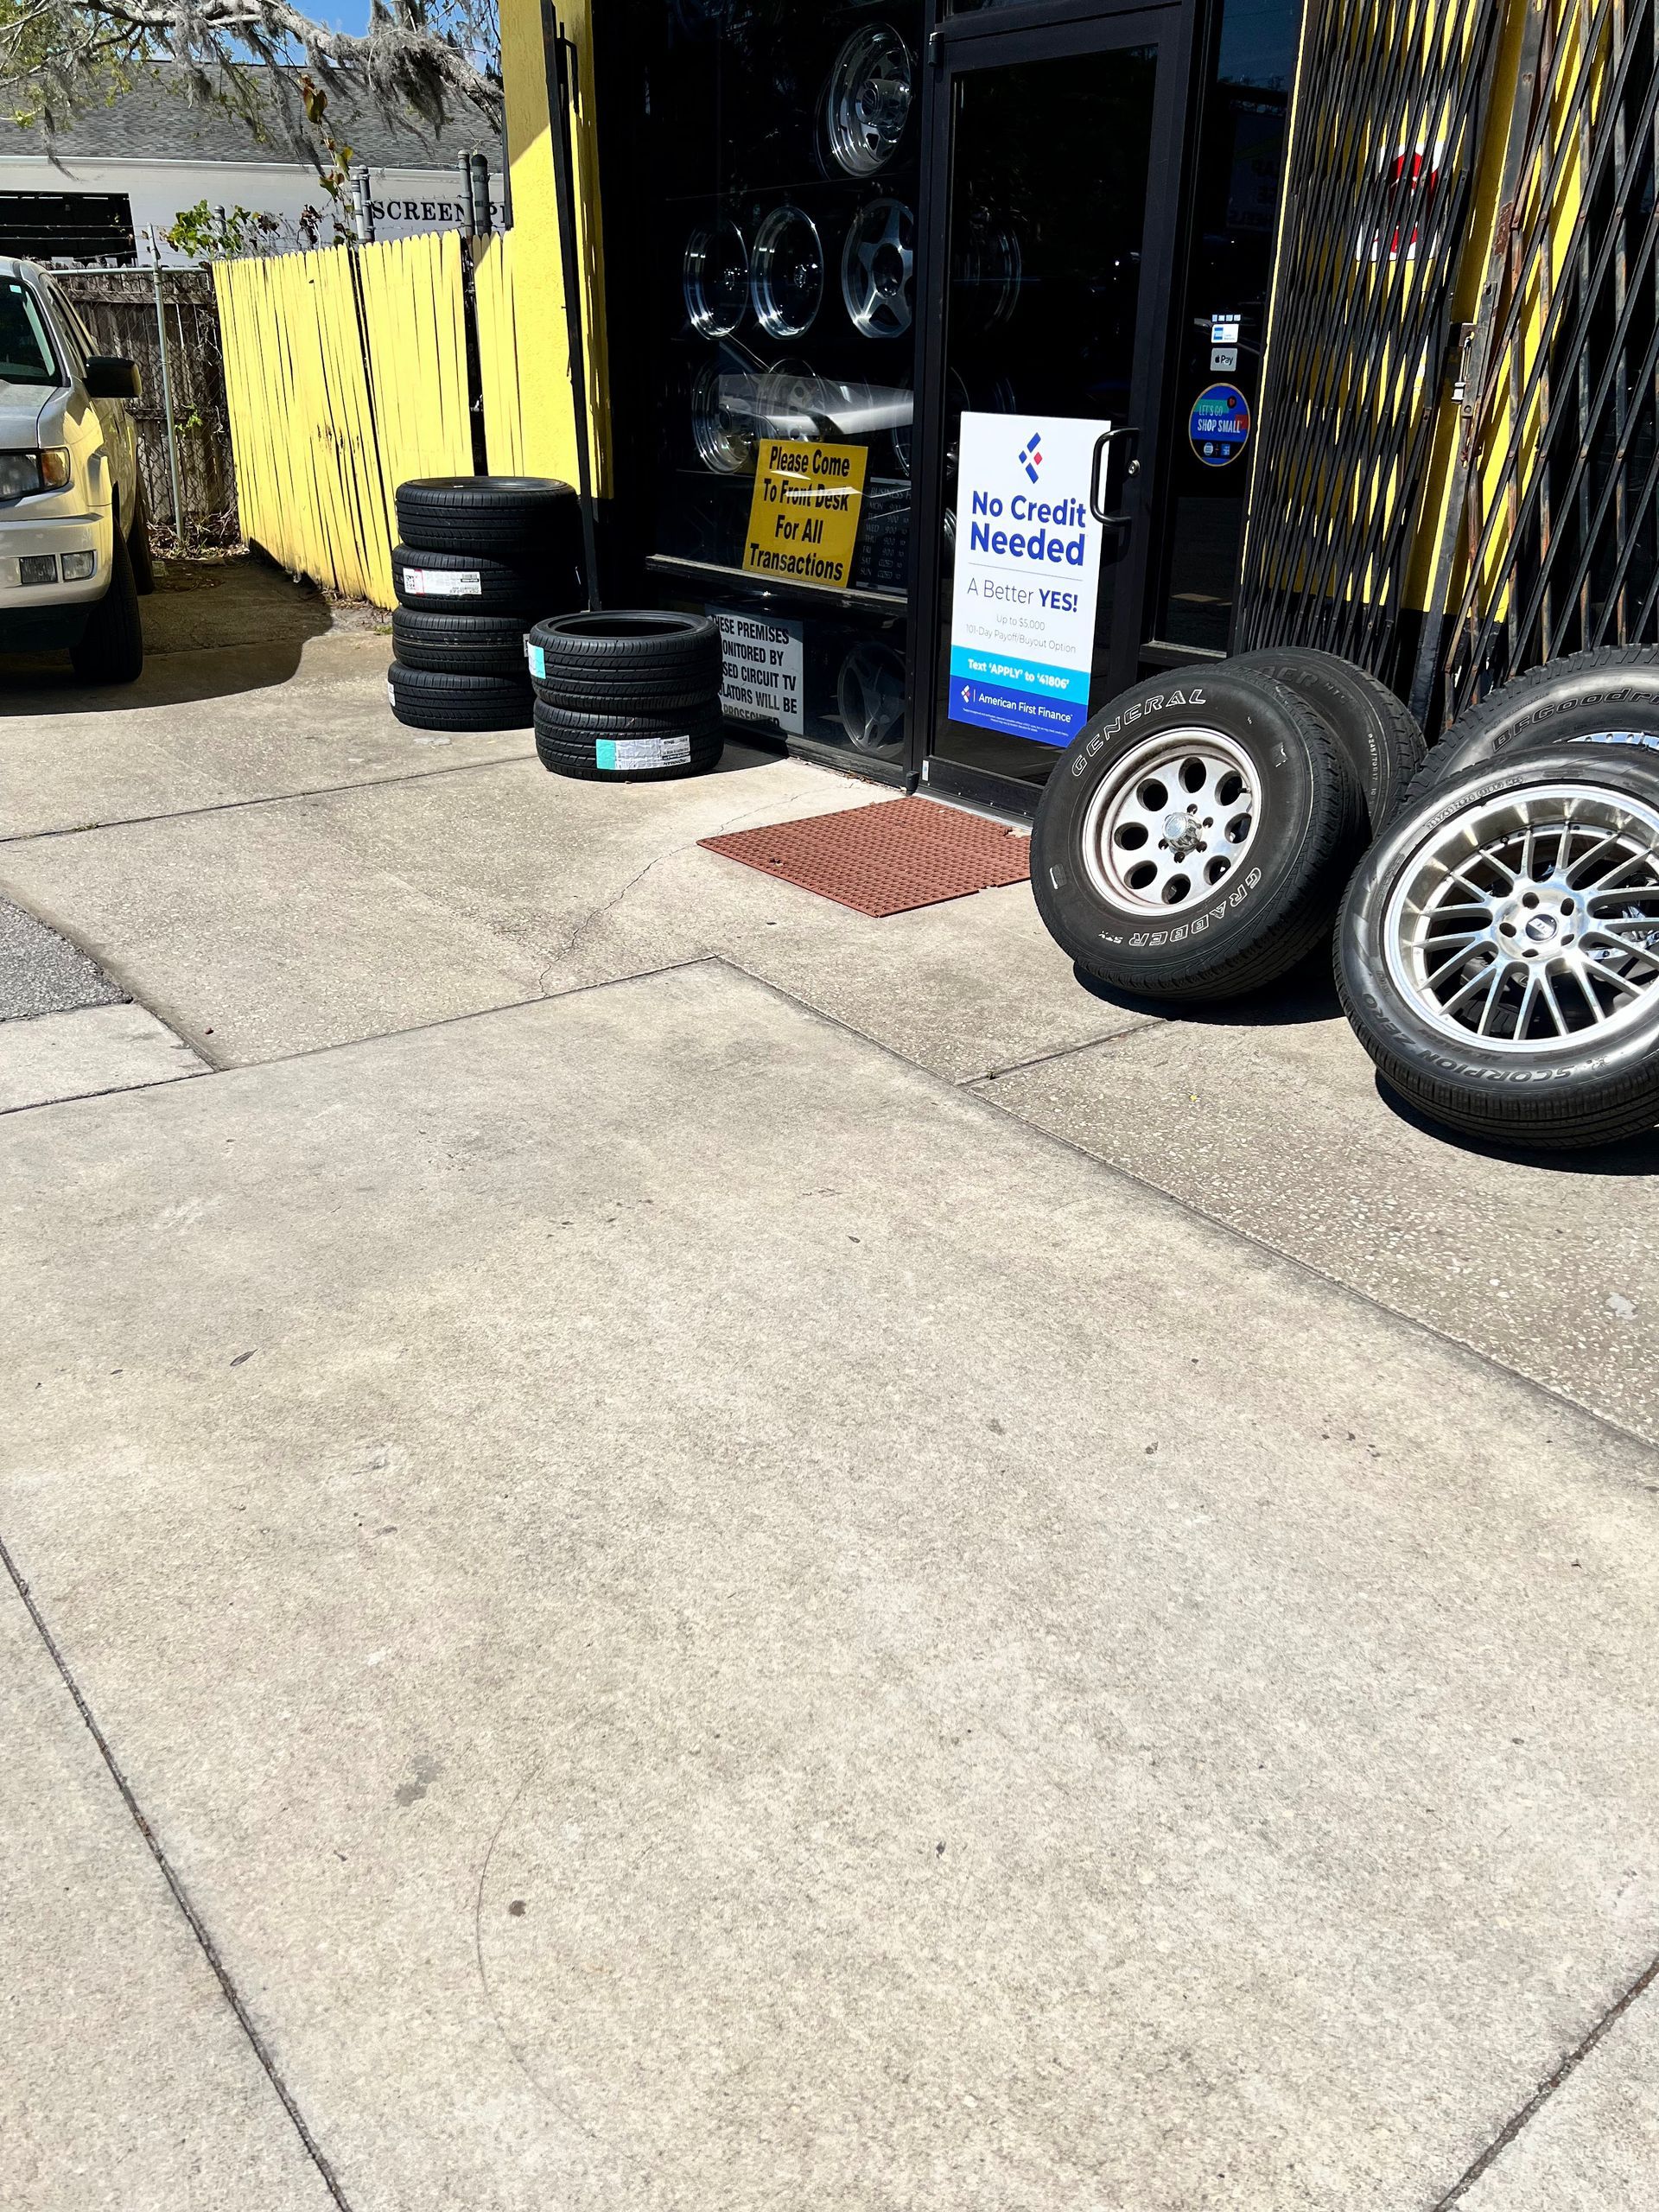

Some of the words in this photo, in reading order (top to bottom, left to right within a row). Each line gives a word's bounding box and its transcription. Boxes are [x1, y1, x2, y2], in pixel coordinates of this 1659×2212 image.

[372, 200, 465, 221] SCREEN
[1220, 355, 1233, 365] Pay
[1214, 405, 1224, 416] GO
[1197, 418, 1217, 432] SHOP
[1217, 420, 1241, 434] SMALL
[769, 446, 809, 473] Please
[812, 448, 850, 476] Come
[763, 478, 777, 503] To
[779, 480, 812, 506] Front
[815, 484, 850, 512] Desk
[972, 490, 1003, 517] No
[1011, 495, 1086, 528] Credit
[775, 514, 799, 540] For
[801, 518, 823, 543] All
[970, 521, 1085, 566] Needed
[750, 543, 843, 582] Transactions
[967, 577, 979, 596] A
[983, 579, 1034, 605] Better
[1039, 588, 1078, 613] YES!
[737, 620, 790, 645] PREMISES
[996, 614, 1007, 626] Up
[1009, 616, 1017, 626] to
[1019, 618, 1046, 632] $5,000
[722, 639, 766, 664] ONITORED
[769, 649, 784, 666] BY
[966, 624, 993, 639] 101-Day
[994, 629, 1047, 649] Payoff/Buyout
[1048, 640, 1076, 654] Option
[722, 661, 738, 679] SED
[741, 665, 779, 689] CIRCUIT
[782, 674, 797, 691] TV
[968, 658, 987, 671] Text
[988, 662, 1023, 680] 'APPLY'
[1025, 671, 1035, 682] to
[755, 691, 779, 711] WILL
[783, 696, 798, 715] BE
[979, 692, 1017, 710] American
[1018, 702, 1037, 715] First
[1038, 707, 1071, 723] Finance
[1072, 689, 1206, 777] GENERAL
[1128, 867, 1262, 946] GRABBER
[1362, 993, 1416, 1046] ZERO
[1416, 1049, 1574, 1083] SCORPION
